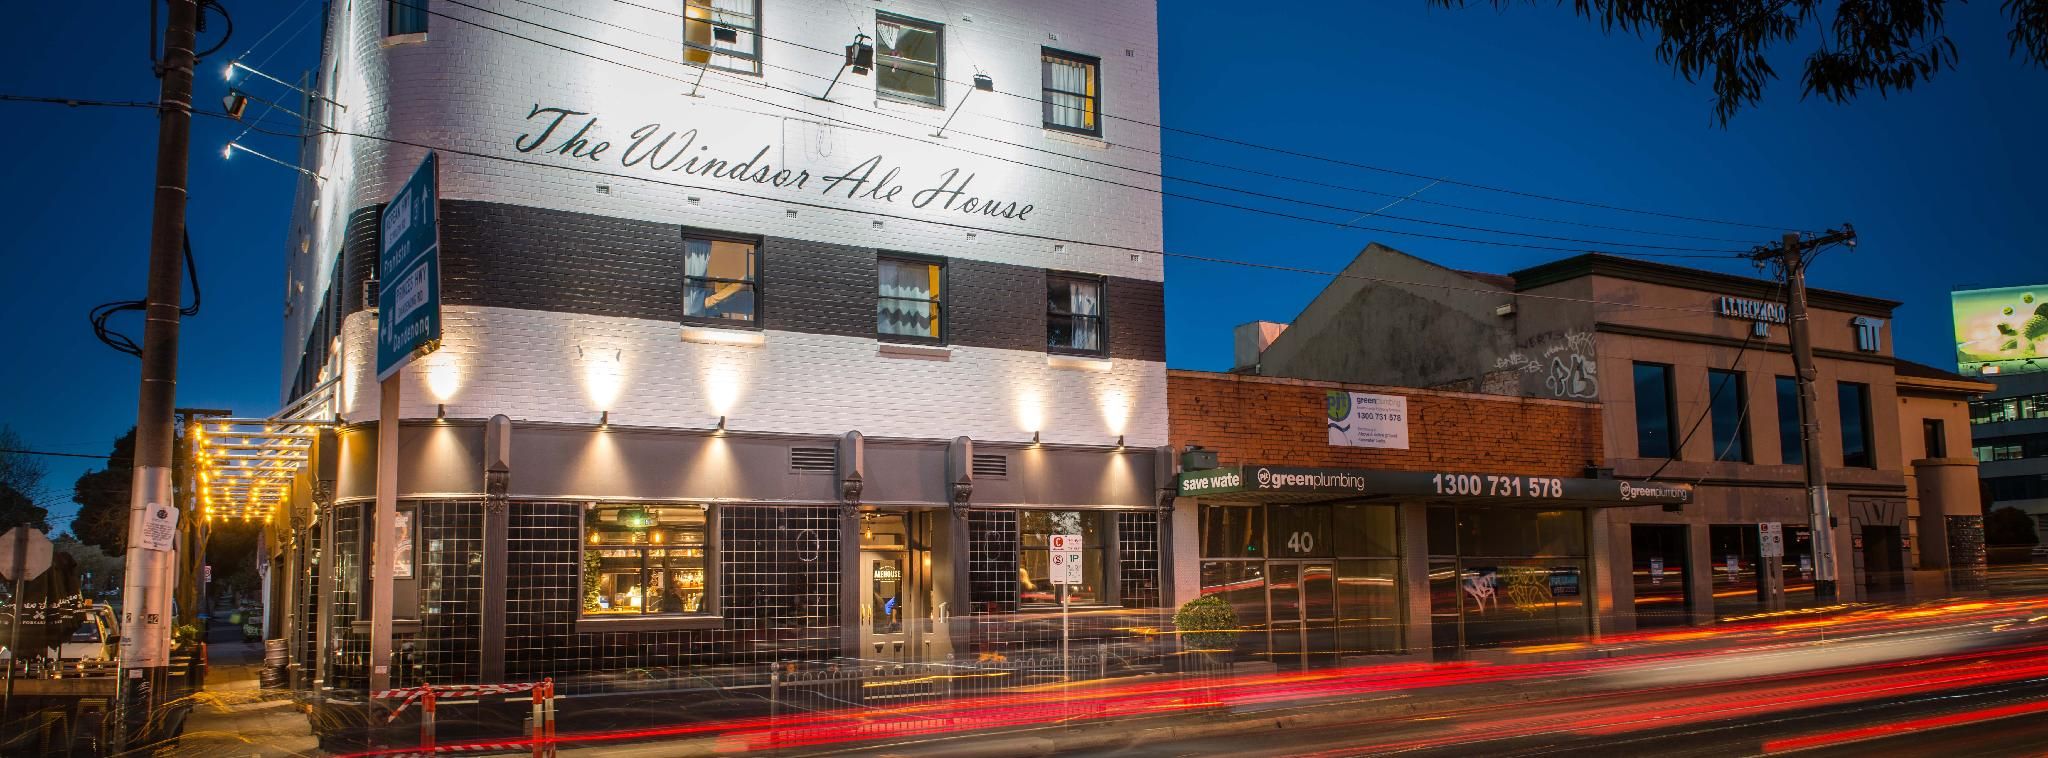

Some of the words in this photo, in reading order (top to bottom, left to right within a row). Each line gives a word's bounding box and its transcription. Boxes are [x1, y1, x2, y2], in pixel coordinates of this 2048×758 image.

[515, 103, 610, 161] The
[621, 123, 809, 190] Windsor
[822, 154, 903, 199] Ale
[911, 167, 1034, 221] House
[1721, 296, 1786, 324] I.T.TECHNOLO
[393, 315, 430, 353] Dandenong
[1357, 412, 1374, 420] 1300
[1374, 413, 1387, 421] 731
[1389, 414, 1402, 422] 578
[1183, 477, 1208, 491] save
[1210, 472, 1240, 488] wate
[1271, 472, 1365, 491] greenplumbing
[1433, 473, 1482, 496] 1300
[1487, 475, 1521, 497] 731
[1528, 477, 1563, 498] 578
[1630, 486, 1687, 500] greenplumbing
[1287, 531, 1314, 553] 40
[1069, 554, 1080, 562] 1P
